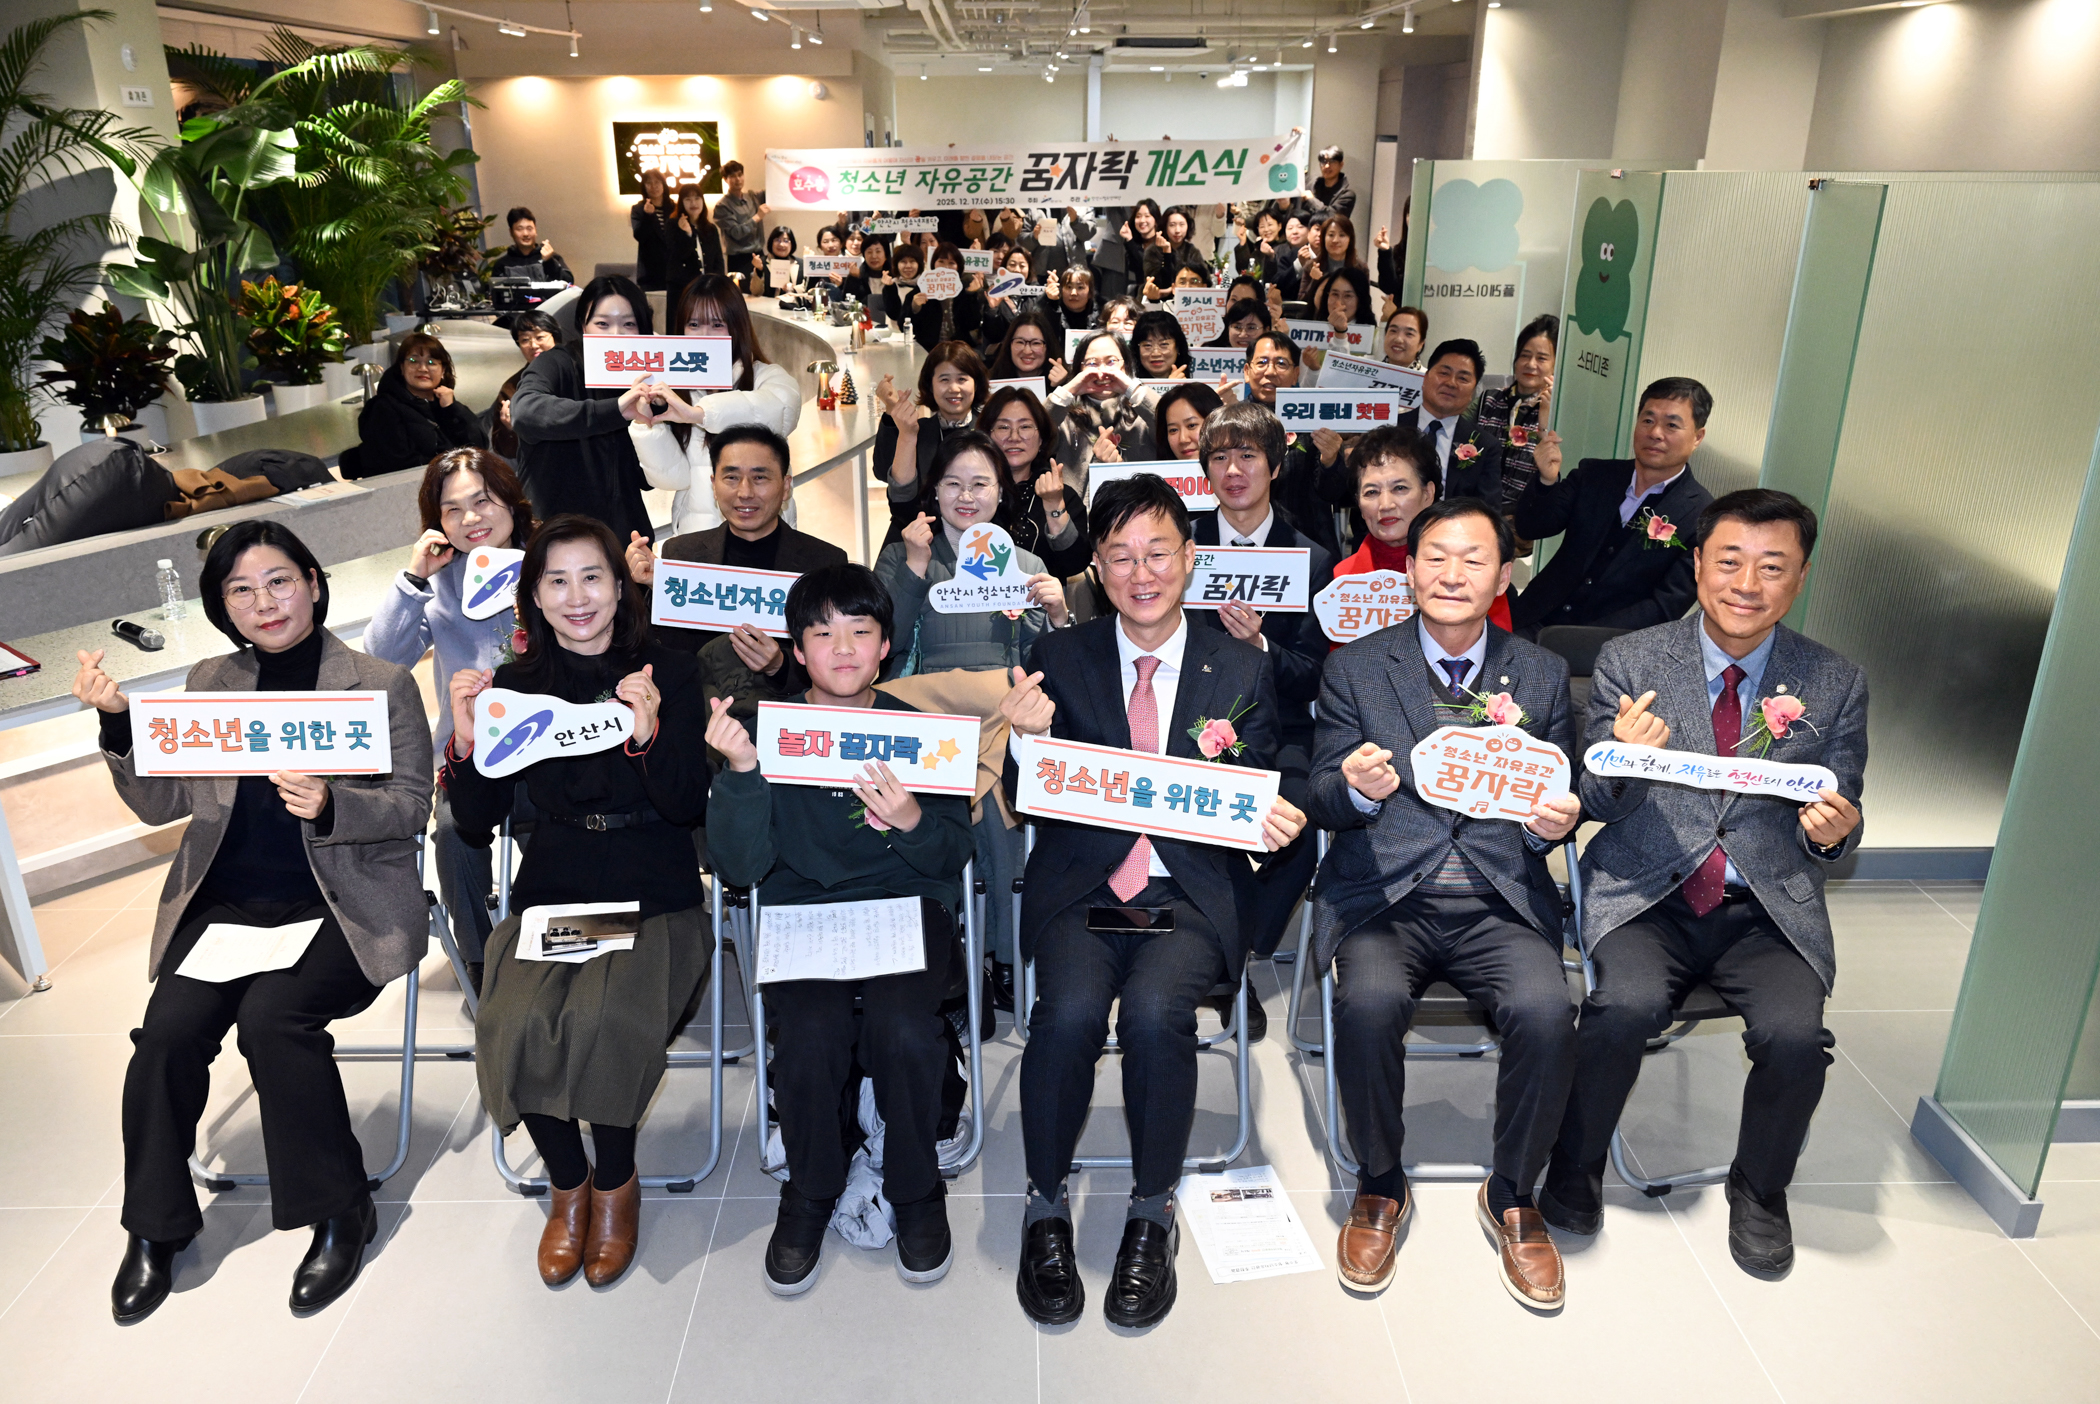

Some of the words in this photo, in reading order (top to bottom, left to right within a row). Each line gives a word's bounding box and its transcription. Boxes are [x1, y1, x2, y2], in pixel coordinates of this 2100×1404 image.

[838, 169, 907, 195] 청소년
[915, 166, 1014, 194] 자유공간
[1019, 150, 1139, 191] 꿈자락
[1145, 148, 1249, 187] 개소식
[936, 198, 957, 206] 2025.
[995, 197, 1015, 206] 15:30
[877, 219, 899, 228] 안산시
[808, 261, 831, 270] 청소년
[926, 282, 956, 294] 꿈자락
[1290, 328, 1325, 342] 여기가
[604, 350, 664, 372] 청소년
[669, 351, 709, 373] 스팟
[1331, 359, 1379, 377] 청소년자유공간
[1577, 349, 1610, 378] 스터디존
[1281, 403, 1315, 420] 우리
[1318, 403, 1353, 420] 동네
[1356, 402, 1391, 420] 핫플
[936, 587, 973, 602] 안산시
[1202, 573, 1291, 603] 꿈자락
[1339, 593, 1373, 604] 청소년
[148, 717, 272, 754] 청소년을
[279, 720, 337, 751] 위한
[345, 720, 372, 751] 곳
[554, 716, 623, 748] 안산시
[777, 728, 834, 757] 놀자
[839, 732, 923, 765] 꿈자락
[1442, 745, 1489, 765] 청소년
[1492, 756, 1555, 779] 자유공간
[1591, 748, 1638, 771] 시민과
[1727, 769, 1781, 789] 혁신도시
[1786, 776, 1826, 794] 안산
[1036, 757, 1157, 808] 청소년을
[1163, 783, 1222, 817] 위한
[1229, 792, 1258, 823] 곳
[1435, 762, 1549, 808] 꿈자락
